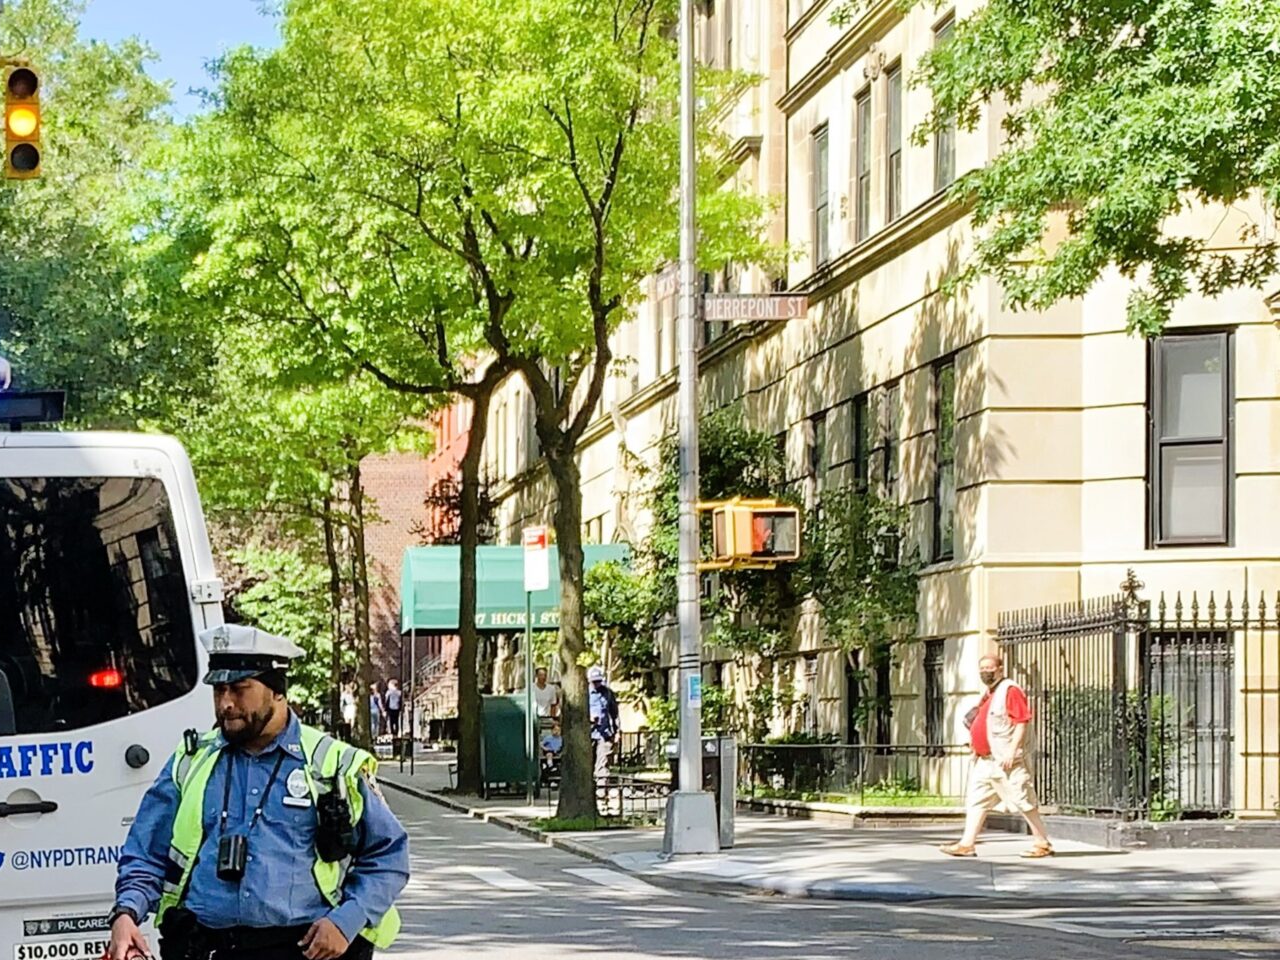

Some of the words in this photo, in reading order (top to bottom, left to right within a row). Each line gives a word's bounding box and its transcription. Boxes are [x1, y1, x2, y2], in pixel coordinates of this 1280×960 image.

[705, 297, 782, 320] PIERREPONT
[787, 297, 804, 317] ST
[58, 920, 76, 930] PAL
[18, 943, 79, 960] $10,000
